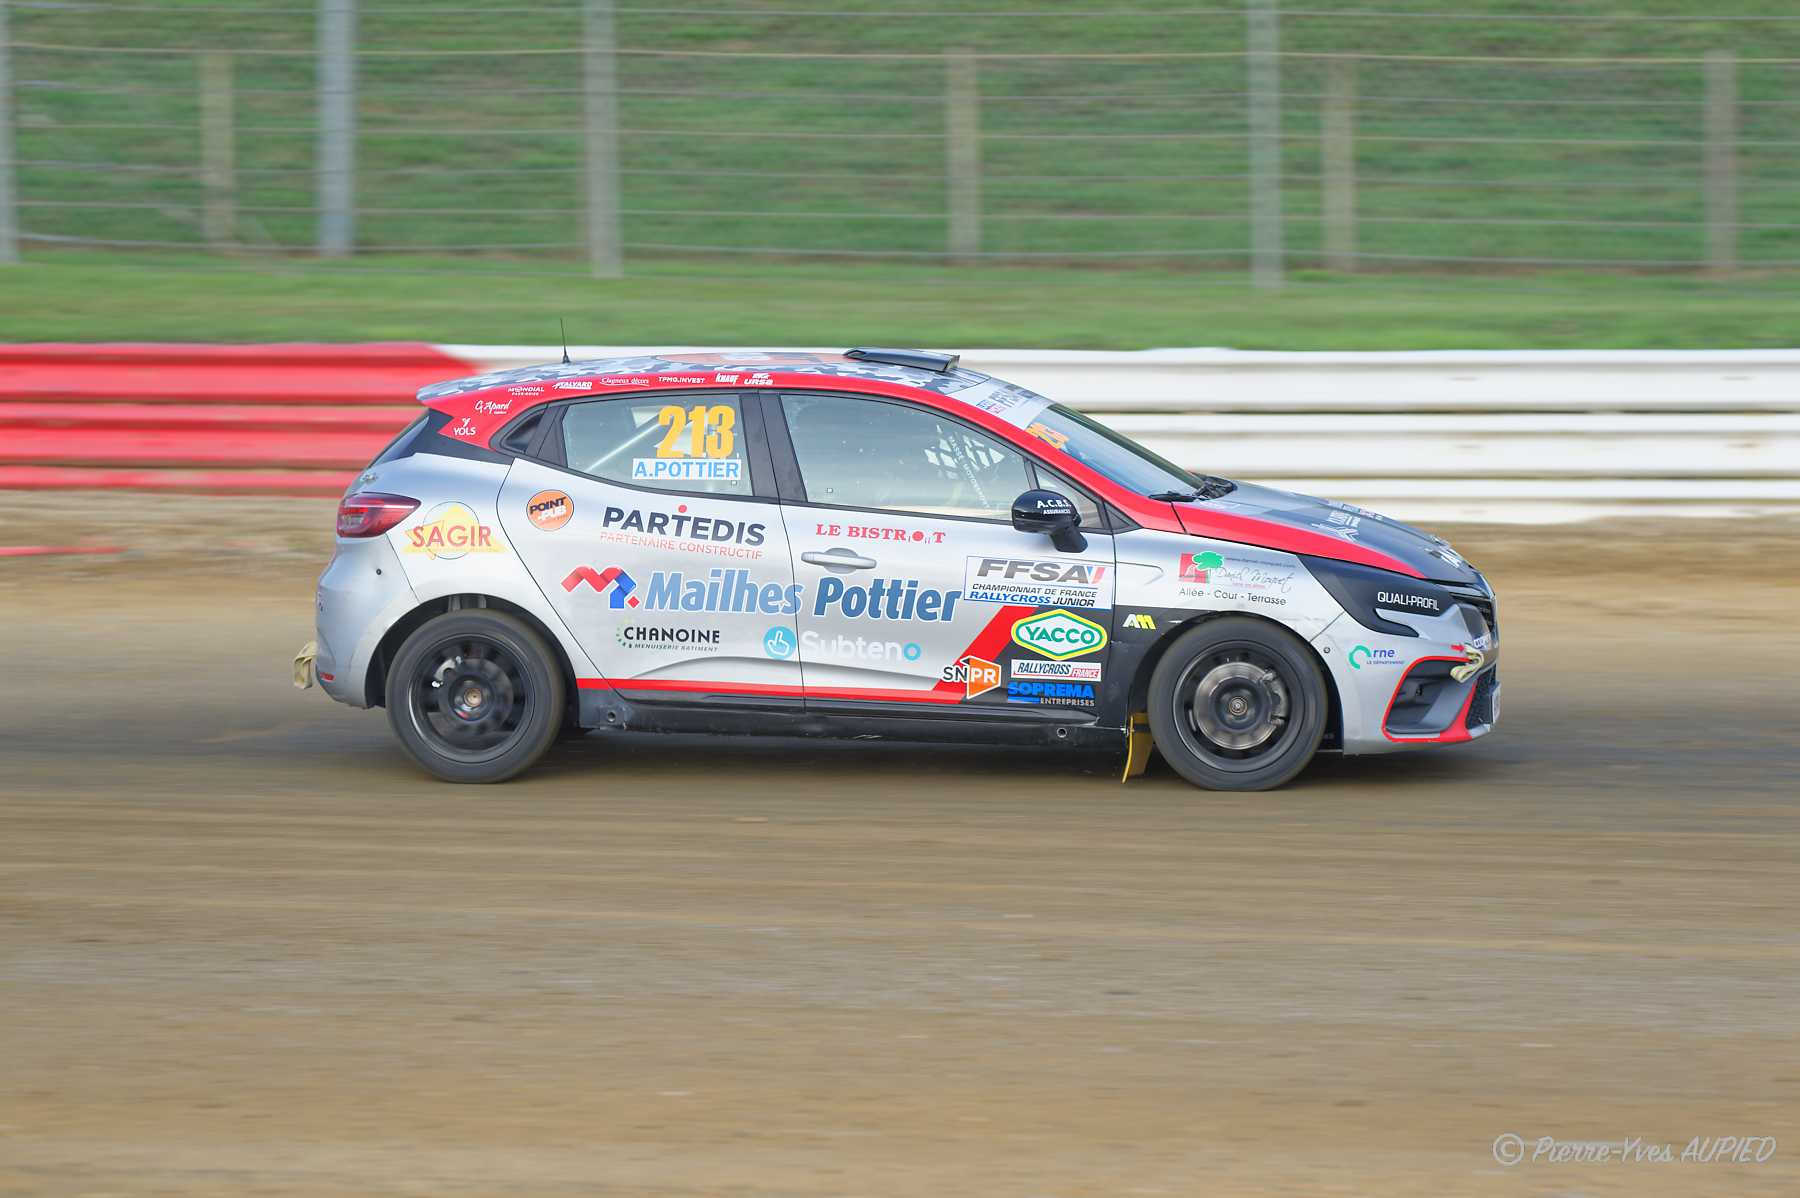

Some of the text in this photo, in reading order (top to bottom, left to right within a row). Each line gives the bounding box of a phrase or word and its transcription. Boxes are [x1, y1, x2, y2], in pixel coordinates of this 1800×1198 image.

[656, 405, 736, 460] 213
[634, 461, 740, 478] A.POTTIER
[529, 496, 567, 515] POINT
[602, 505, 766, 547] PARTEDIS
[816, 523, 841, 537] LE
[412, 525, 492, 548] SAGIR
[600, 531, 764, 561] PARTENAIRE CONSTRUCTIF
[976, 558, 1090, 584] FFSA
[644, 569, 962, 621] Mailhes Pottier
[969, 591, 1096, 608] RALLYCROSS JUNIOR
[972, 583, 1097, 599] CHAMPIONNAT DE FRANCE
[1214, 589, 1238, 600] Cour
[1247, 592, 1287, 606] Terrasse
[1377, 591, 1440, 611] QUALI-PROFIL
[623, 626, 720, 644] CHANOINE
[1025, 625, 1096, 645] YACCO
[801, 630, 922, 662] Subteno
[1017, 662, 1072, 676] RALLYCROSS
[1008, 681, 1095, 699] SOPREMA
[1040, 697, 1095, 707] ENTREPRISES
